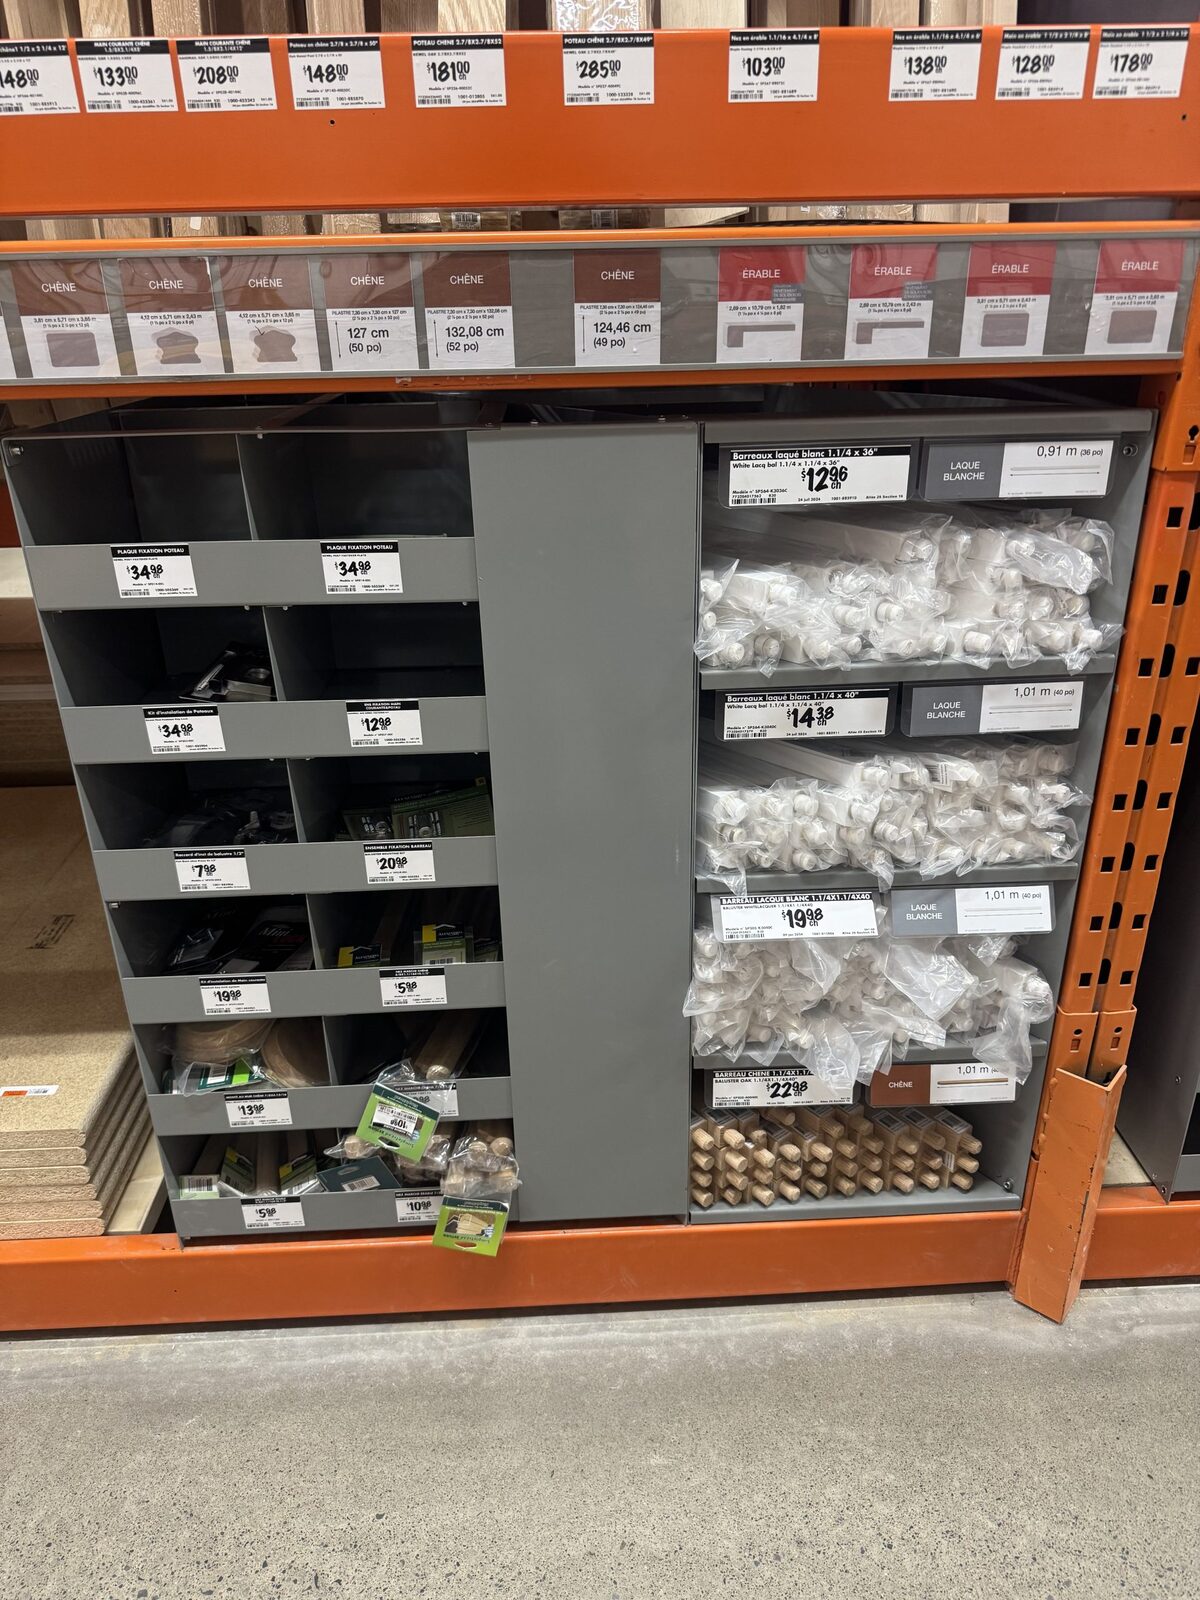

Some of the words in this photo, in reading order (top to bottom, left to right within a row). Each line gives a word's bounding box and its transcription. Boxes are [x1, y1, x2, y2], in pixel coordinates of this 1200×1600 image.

[874, 264, 912, 277] ÉRABLE
[992, 261, 1030, 274] ÉRABLE
[1121, 259, 1160, 272] ÉRABLE
[601, 269, 635, 280] CHÊNE
[742, 266, 780, 279] ÉRABLE
[248, 276, 283, 288] CHÊNE
[350, 274, 385, 285] CHÊNE
[450, 273, 484, 284] CHÊNE
[41, 281, 76, 293] CHÊNE
[148, 279, 184, 290] CHÊNE
[347, 328, 366, 338] 127
[371, 330, 389, 338] cm
[445, 326, 482, 339] 132,08
[486, 328, 504, 337] cm
[593, 321, 630, 334] 124,46
[633, 323, 652, 333] cm
[446, 340, 460, 353] (52
[463, 340, 479, 353] po)
[593, 336, 607, 348] (49
[610, 336, 626, 348] po)
[349, 342, 363, 354] (50
[366, 342, 382, 354] po)
[775, 450, 799, 460] laqué
[802, 449, 825, 458] blanc
[828, 448, 851, 457] 1.1/4
[1037, 445, 1062, 458] 0,91
[1066, 447, 1077, 456] m
[1092, 448, 1104, 456] po)
[951, 461, 981, 470] LAQUE
[943, 472, 985, 481] BLANCHE
[831, 480, 842, 490] ch
[766, 694, 787, 702] laqué
[1014, 687, 1036, 698] 1,01
[1040, 688, 1051, 696] m
[1064, 688, 1075, 696] po)
[933, 702, 961, 710] LAQUE
[927, 711, 966, 719] BLANCHE
[817, 718, 827, 726] ch
[985, 890, 1006, 901] 1,01
[809, 919, 818, 927] ch
[958, 1065, 976, 1075] 1,01
